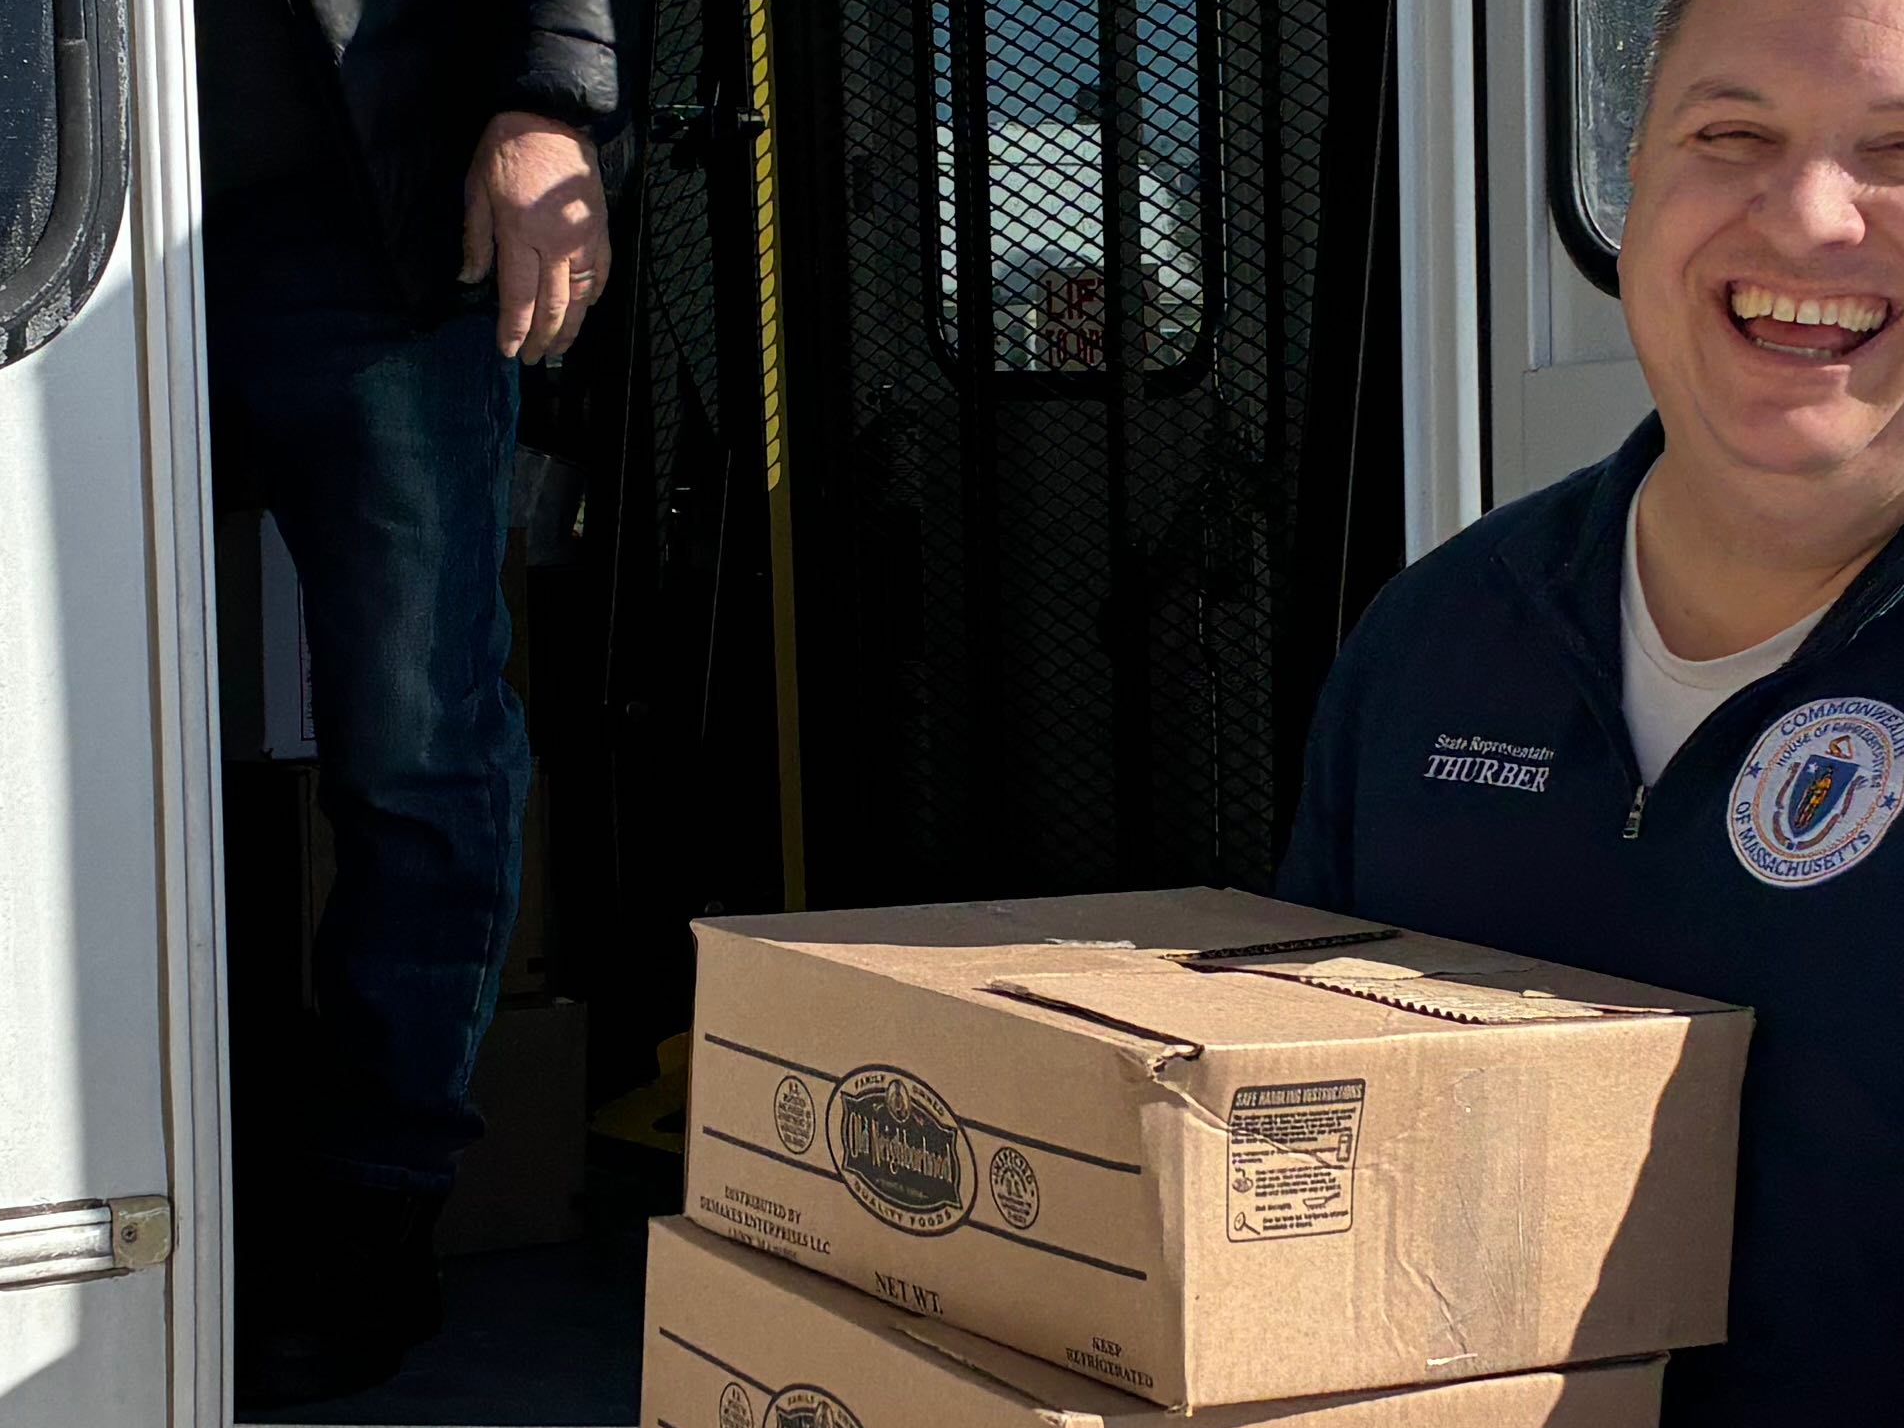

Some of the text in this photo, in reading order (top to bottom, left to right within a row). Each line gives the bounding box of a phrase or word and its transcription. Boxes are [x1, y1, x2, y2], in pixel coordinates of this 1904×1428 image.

[1046, 278, 1104, 320] LIF
[1435, 733, 1468, 750] State
[1776, 732, 1812, 768] HOUSE
[1814, 724, 1830, 738] OF
[1424, 755, 1549, 792] THURBER
[1735, 801, 1872, 877] OF MASSACHUSETTS
[1234, 1083, 1362, 1108] SAFE HANDLING INSTRUCTIONS
[849, 1111, 869, 1158] Old
[871, 1117, 953, 1184] Neighborhood
[724, 1185, 802, 1225] DISTRIBUTED BY
[854, 1180, 903, 1222] QUALITY
[909, 1208, 952, 1228] FOODS
[745, 1211, 808, 1247] ENTERPRISES
[809, 1235, 832, 1255] LLC
[874, 1270, 943, 1315] NET WT.
[1065, 1347, 1154, 1388] REFRIGERATED
[1092, 1336, 1122, 1358] KEEP
